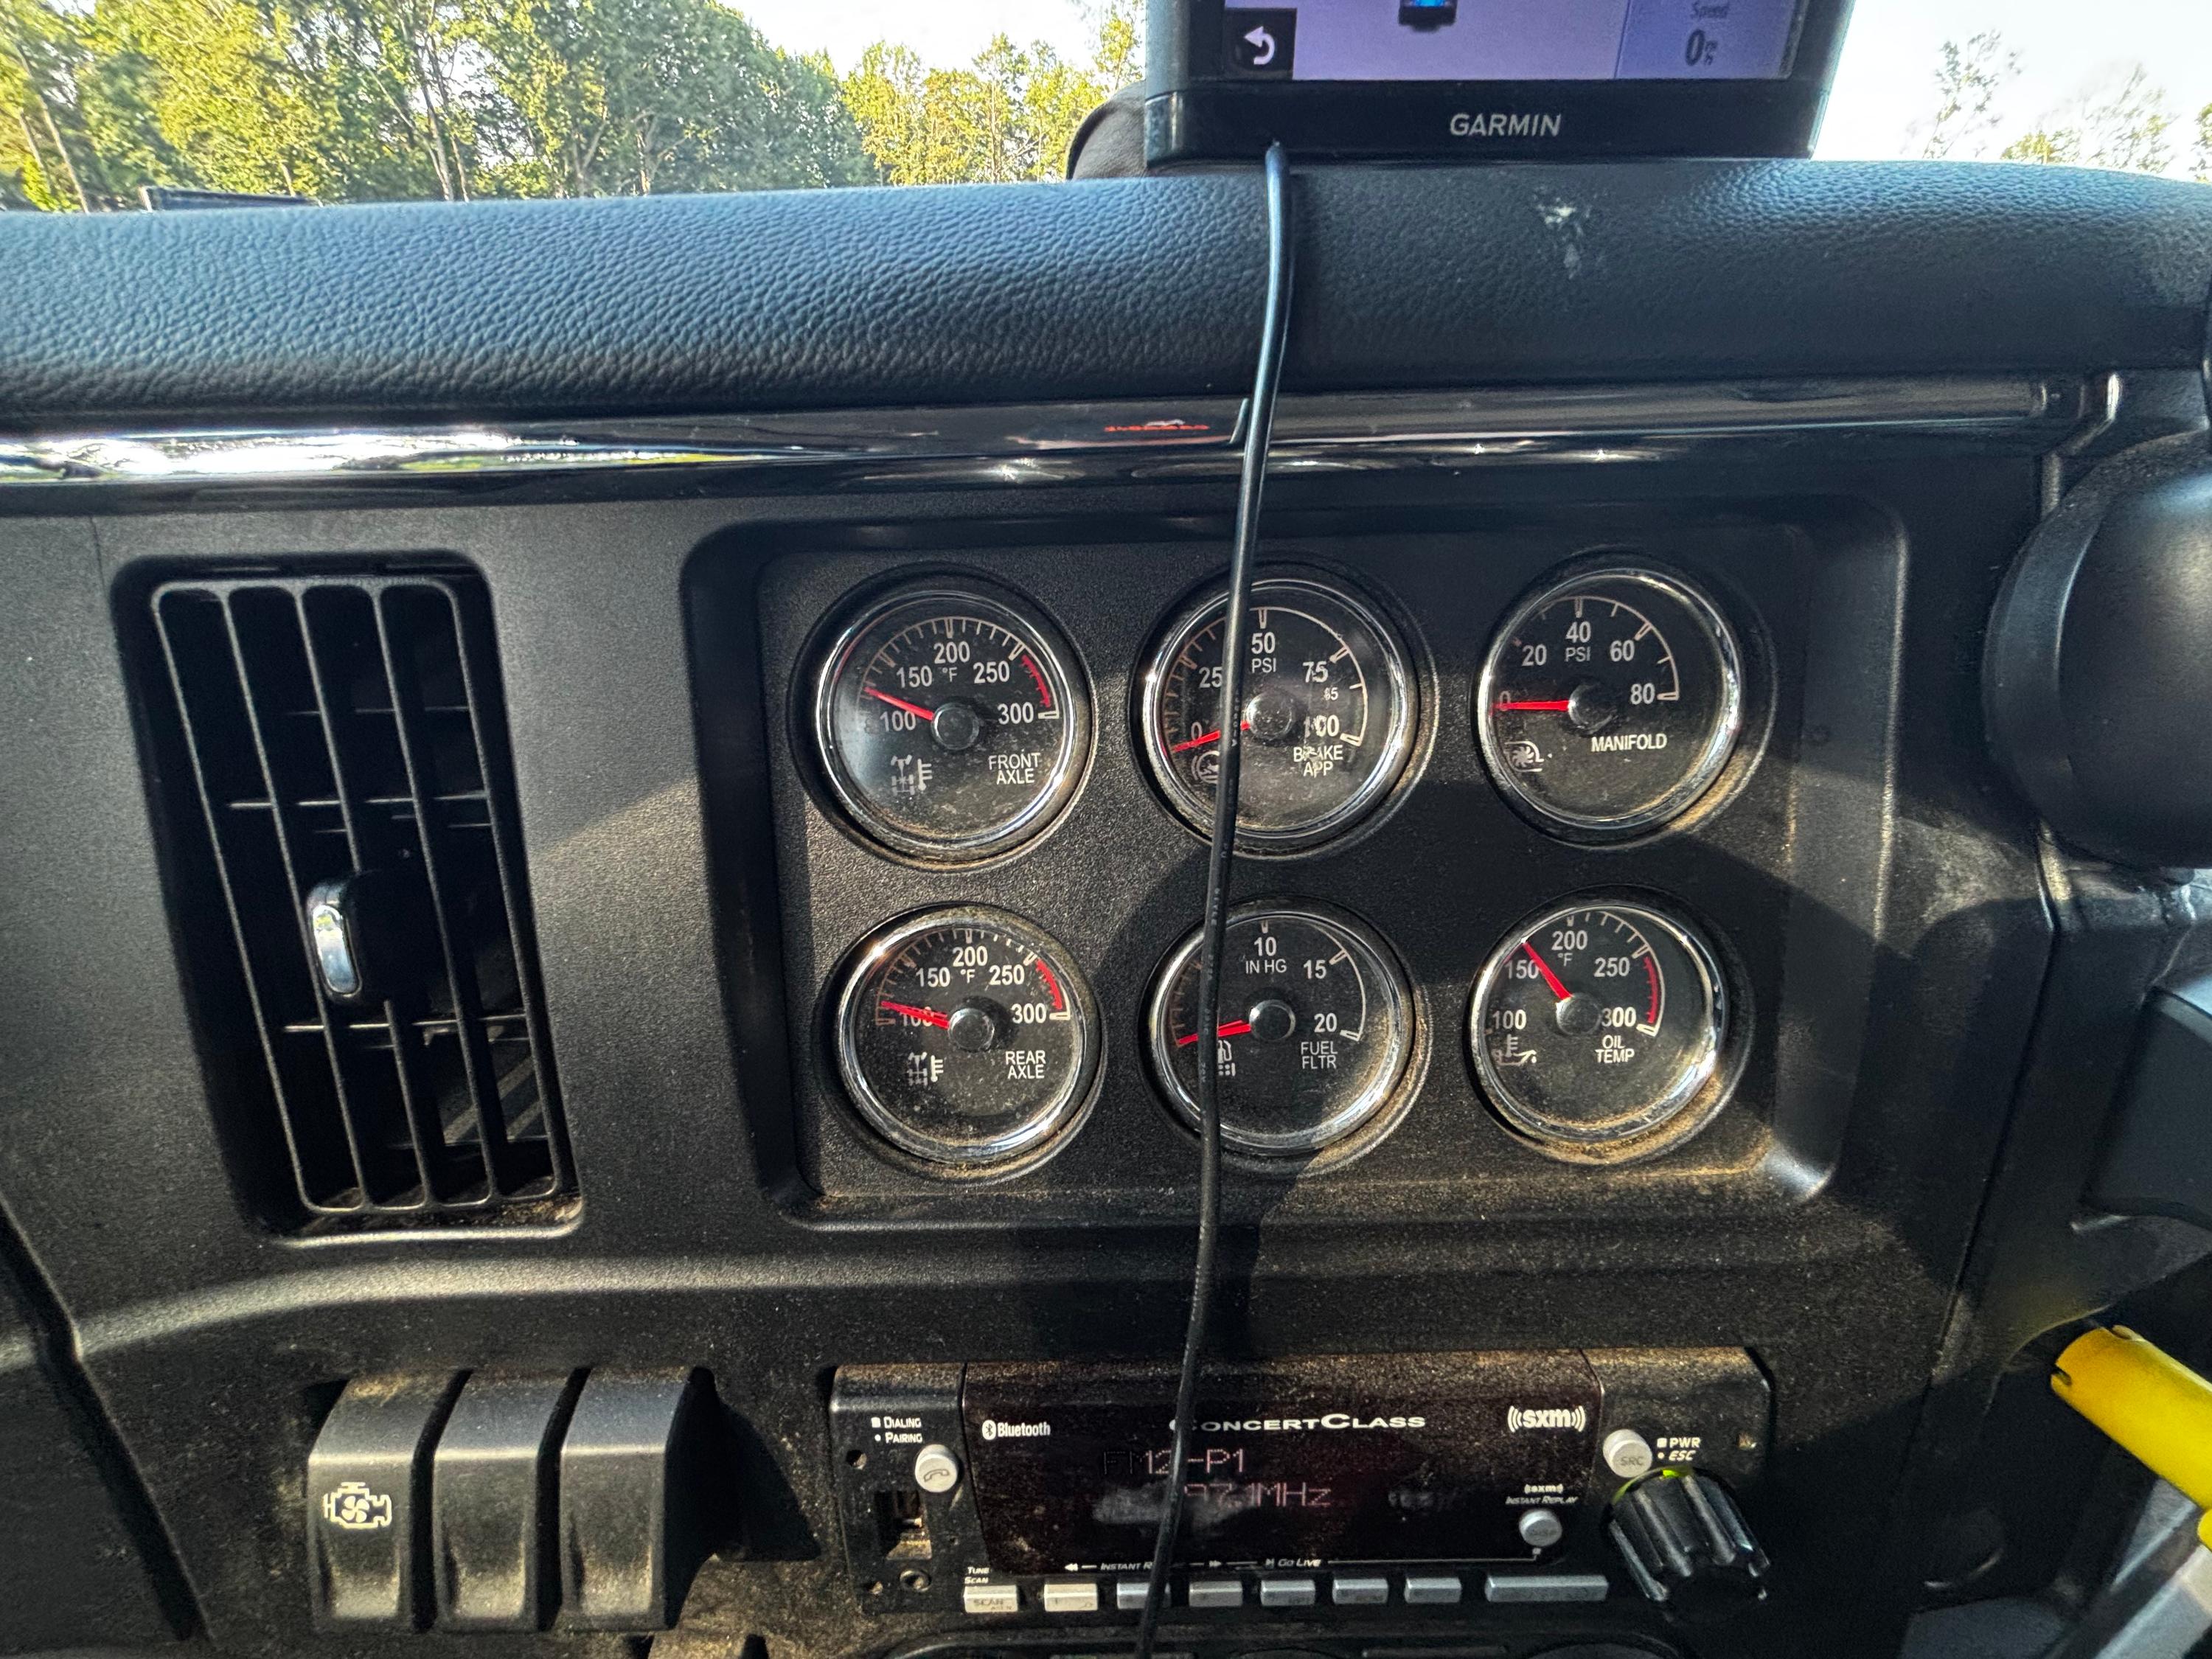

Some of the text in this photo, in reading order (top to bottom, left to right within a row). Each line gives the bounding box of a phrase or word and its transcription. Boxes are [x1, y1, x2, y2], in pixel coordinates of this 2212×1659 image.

[1686, 29, 1705, 66] 0
[1450, 113, 1562, 136] GARMIN
[1565, 621, 1592, 643] 40
[933, 641, 970, 664] 200
[1251, 631, 1276, 654] 50
[1610, 640, 1635, 661] 60
[1521, 644, 1548, 667] 20
[1565, 647, 1591, 662] PSI
[973, 661, 1010, 684] 250
[1251, 658, 1276, 673] PSI
[1303, 661, 1329, 684] 75
[896, 665, 933, 688] 150
[1199, 667, 1223, 689] 25
[1630, 683, 1655, 705] 80
[880, 711, 917, 732] 100
[998, 701, 1034, 725] 300
[1191, 721, 1203, 742] 0
[1304, 714, 1340, 737] 100
[1591, 733, 1667, 752] MANIFOLD
[989, 753, 1040, 771] FRONT
[1293, 745, 1343, 762] BRAKE
[996, 768, 1035, 785] AXLE
[1303, 760, 1334, 778] APP
[1254, 936, 1276, 956] 10
[1551, 931, 1587, 950] 200
[952, 945, 988, 967] 200
[989, 964, 1024, 986] 250
[1245, 960, 1287, 974] IN HG
[1303, 959, 1326, 980] 15
[1504, 959, 1540, 979] 150
[1593, 957, 1630, 978] 250
[916, 967, 950, 988] 150
[1011, 1003, 1046, 1023] 300
[1314, 1012, 1338, 1033] 20
[1492, 1009, 1527, 1030] 100
[1601, 1007, 1637, 1027] 300
[1301, 1041, 1338, 1056] FUEL
[1601, 1034, 1626, 1049] OIL
[1005, 1050, 1046, 1065] REAR
[1302, 1055, 1337, 1069] FLTR
[1595, 1048, 1635, 1064] TEMP
[1007, 1064, 1045, 1079] AXLE
[883, 1416, 922, 1428] DIALING
[997, 1421, 1051, 1437] Bluetooth
[885, 1432, 922, 1444] PAIRING
[1669, 1437, 1701, 1448] PWR
[1621, 1456, 1644, 1466] SRC
[1669, 1450, 1697, 1461] ESC
[967, 1566, 990, 1574] TUNE
[1101, 1562, 1141, 1571] INSTANT
